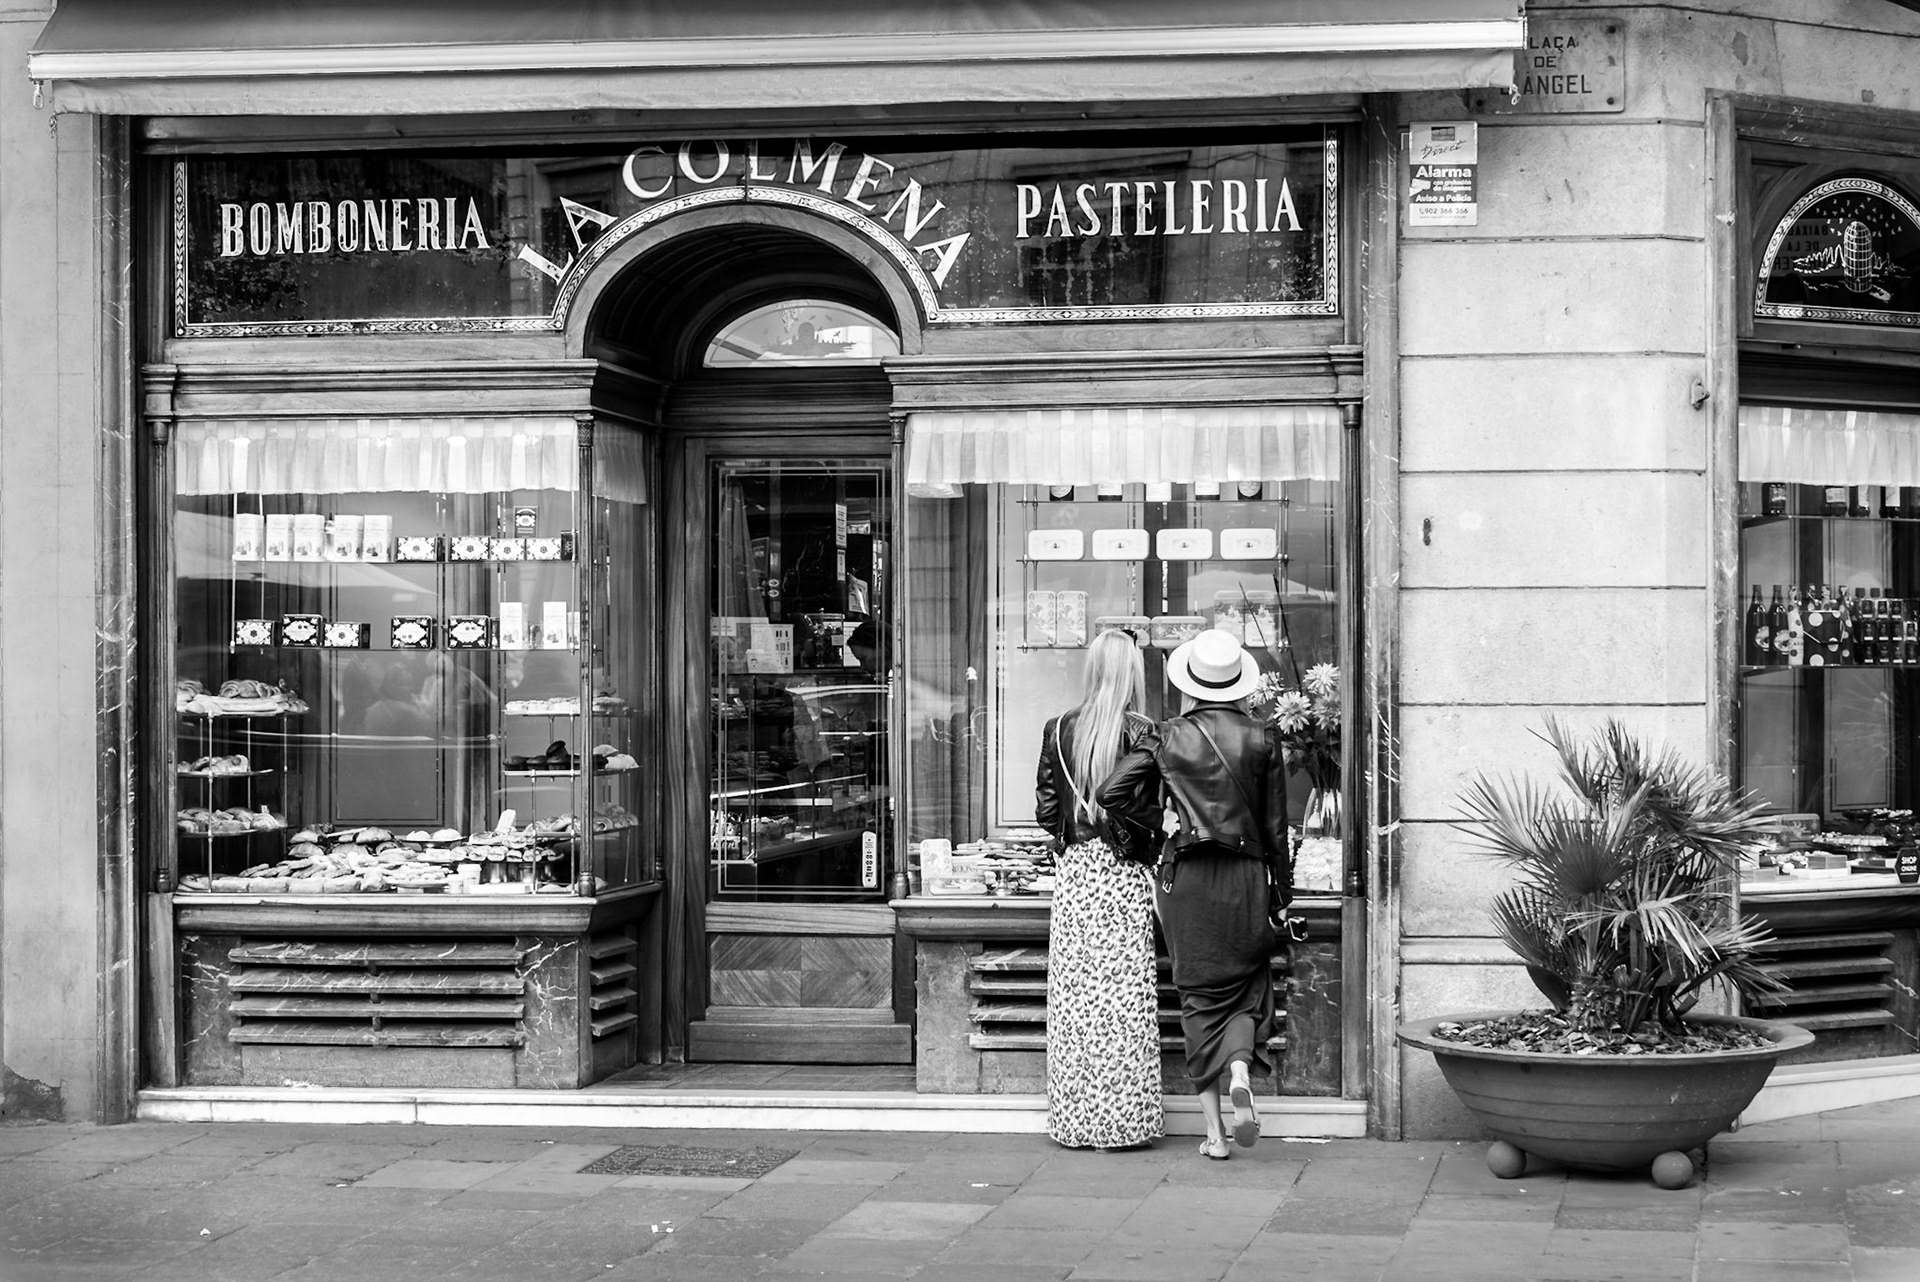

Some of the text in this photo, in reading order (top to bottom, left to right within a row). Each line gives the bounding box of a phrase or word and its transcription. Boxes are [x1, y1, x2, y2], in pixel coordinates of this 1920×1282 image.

[1528, 36, 1578, 53] LAÇA
[1534, 55, 1557, 68] DE
[1415, 165, 1472, 178] Alarma
[1415, 194, 1438, 202] Aviso
[1445, 194, 1472, 202] Policía
[518, 139, 971, 291] LA COLMENA
[1016, 177, 1304, 239] PASTELERIA
[220, 196, 491, 258] BOMBONERIA
[1901, 856, 1918, 865] SHOP
